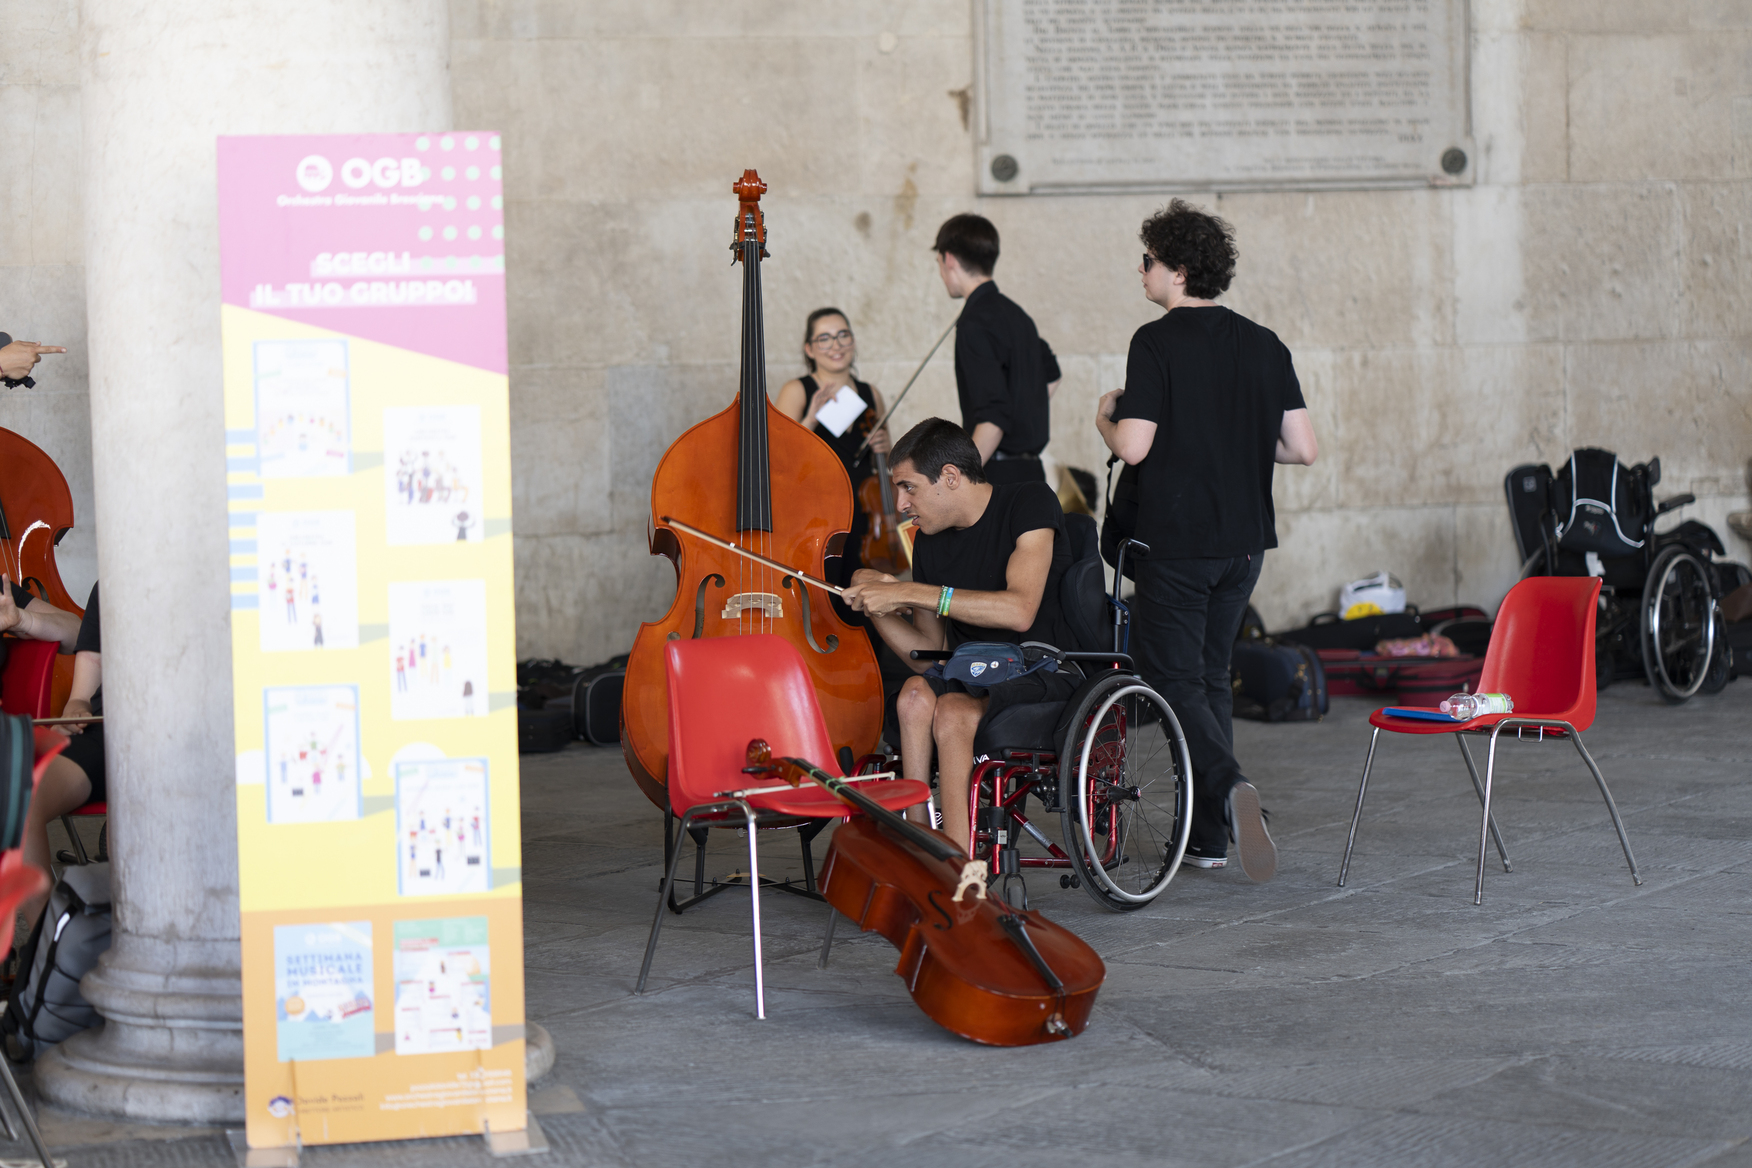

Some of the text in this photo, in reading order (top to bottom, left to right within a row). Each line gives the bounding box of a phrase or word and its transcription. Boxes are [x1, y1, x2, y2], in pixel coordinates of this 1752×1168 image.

[341, 157, 424, 189] OGB
[277, 194, 332, 207] Orchestra
[334, 193, 388, 206] Giovanile
[316, 251, 410, 274] SCEGLI
[255, 280, 473, 306] IL TUO GRUPPO!
[286, 952, 363, 965] SETTIMANA
[287, 964, 363, 977] MUSICALE
